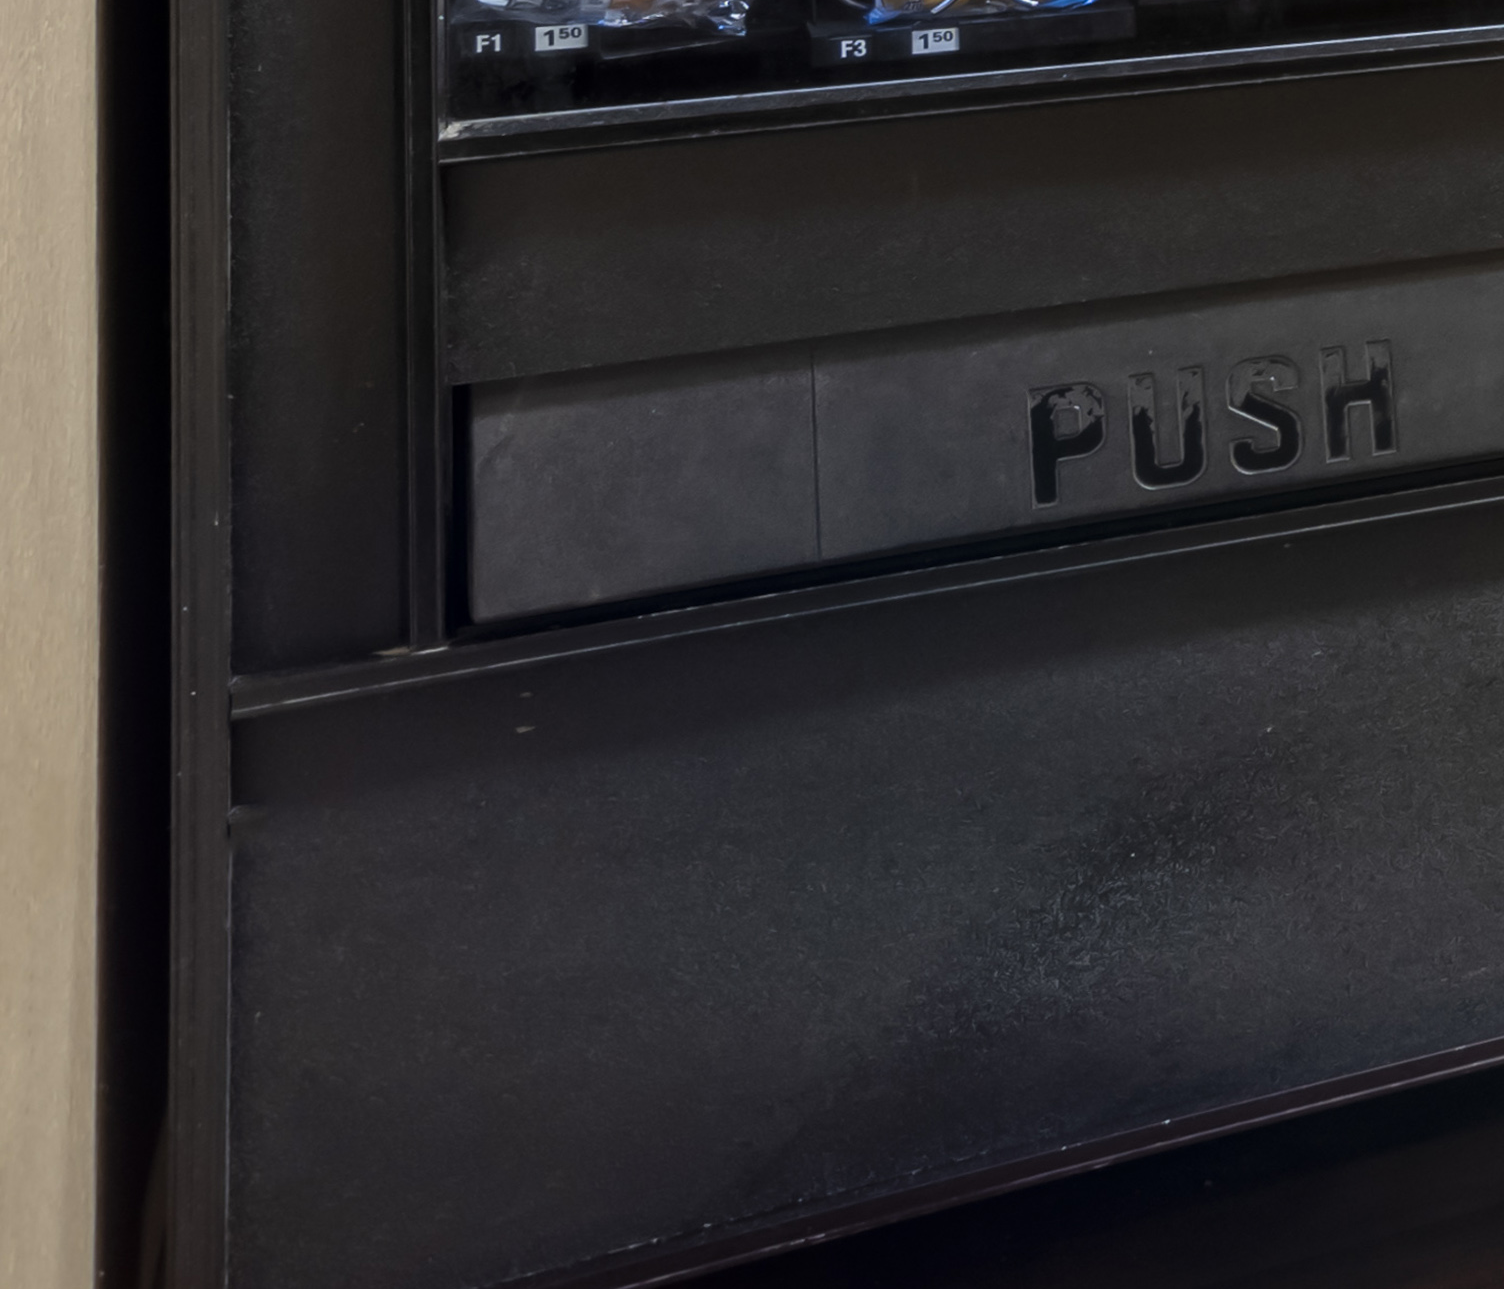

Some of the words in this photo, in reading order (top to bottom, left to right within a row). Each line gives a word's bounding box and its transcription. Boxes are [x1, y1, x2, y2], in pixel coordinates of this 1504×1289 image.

[476, 33, 502, 53] F1
[841, 40, 867, 58] F3
[1027, 338, 1397, 509] PUSH
